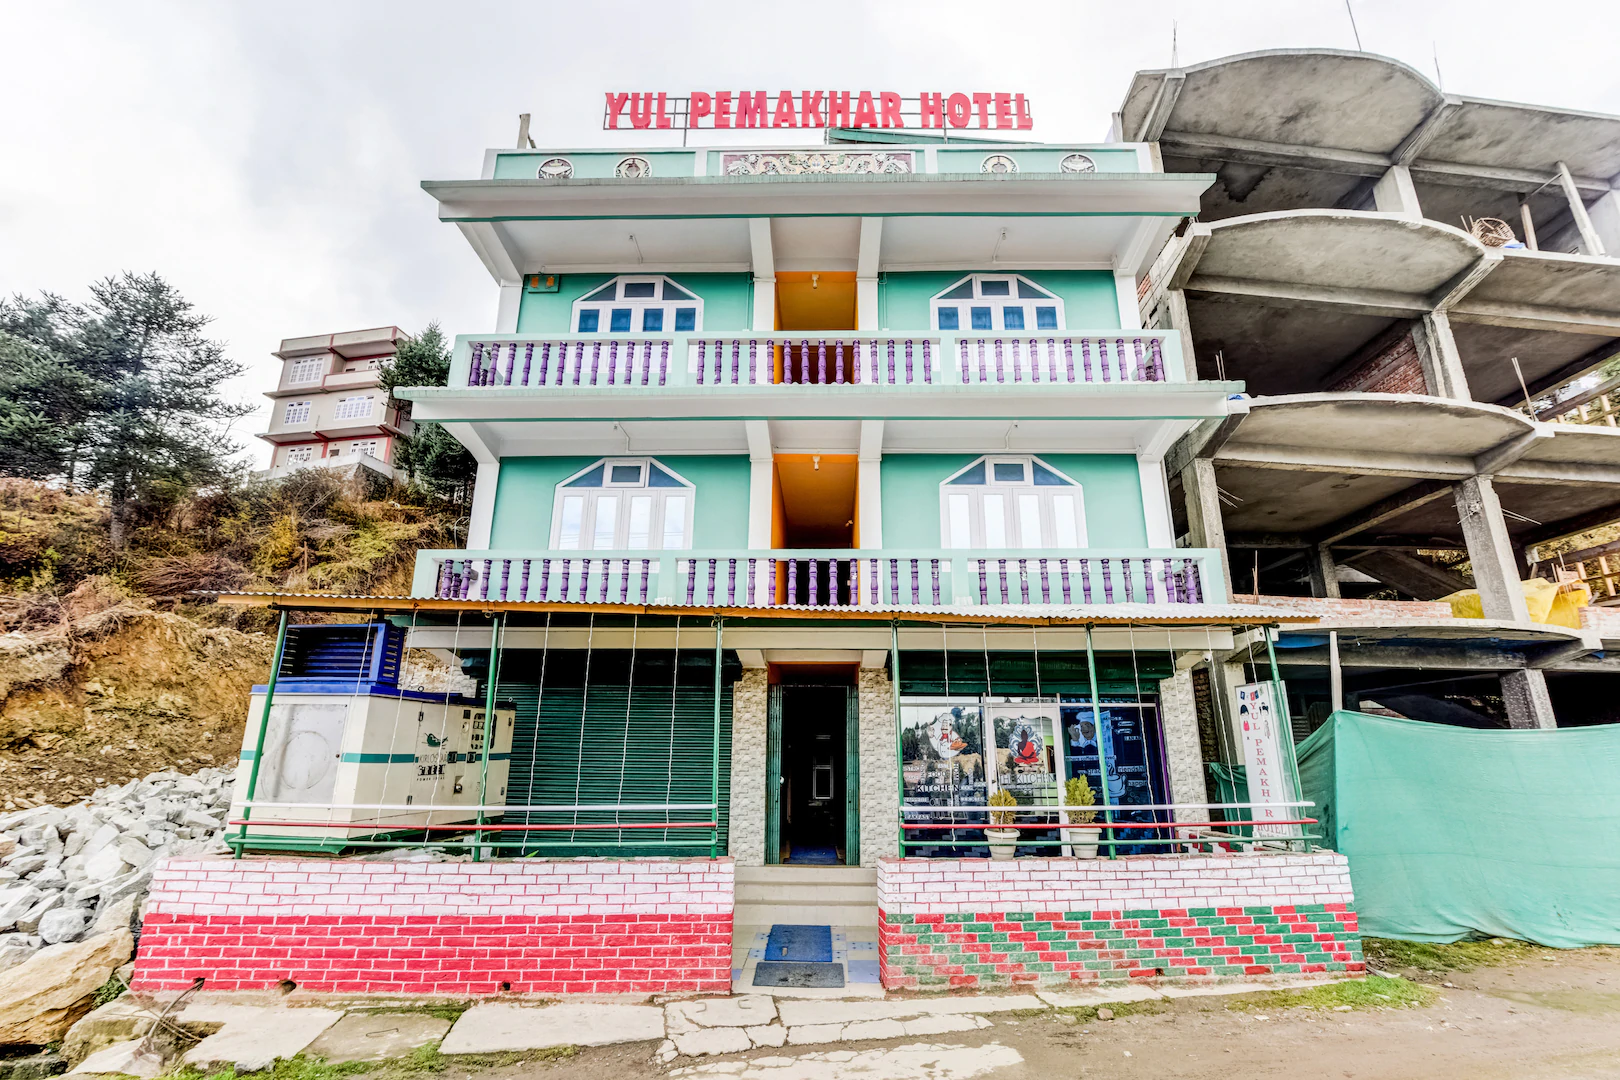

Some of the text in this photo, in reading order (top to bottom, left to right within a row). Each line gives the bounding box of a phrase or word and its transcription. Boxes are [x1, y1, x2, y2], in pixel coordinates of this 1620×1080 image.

[605, 91, 1034, 131] YUL PEMAKHAR HOTEL
[1249, 702, 1261, 731] YUL
[916, 784, 959, 792] KITCHEN
[1016, 773, 1056, 784] KITCHEN
